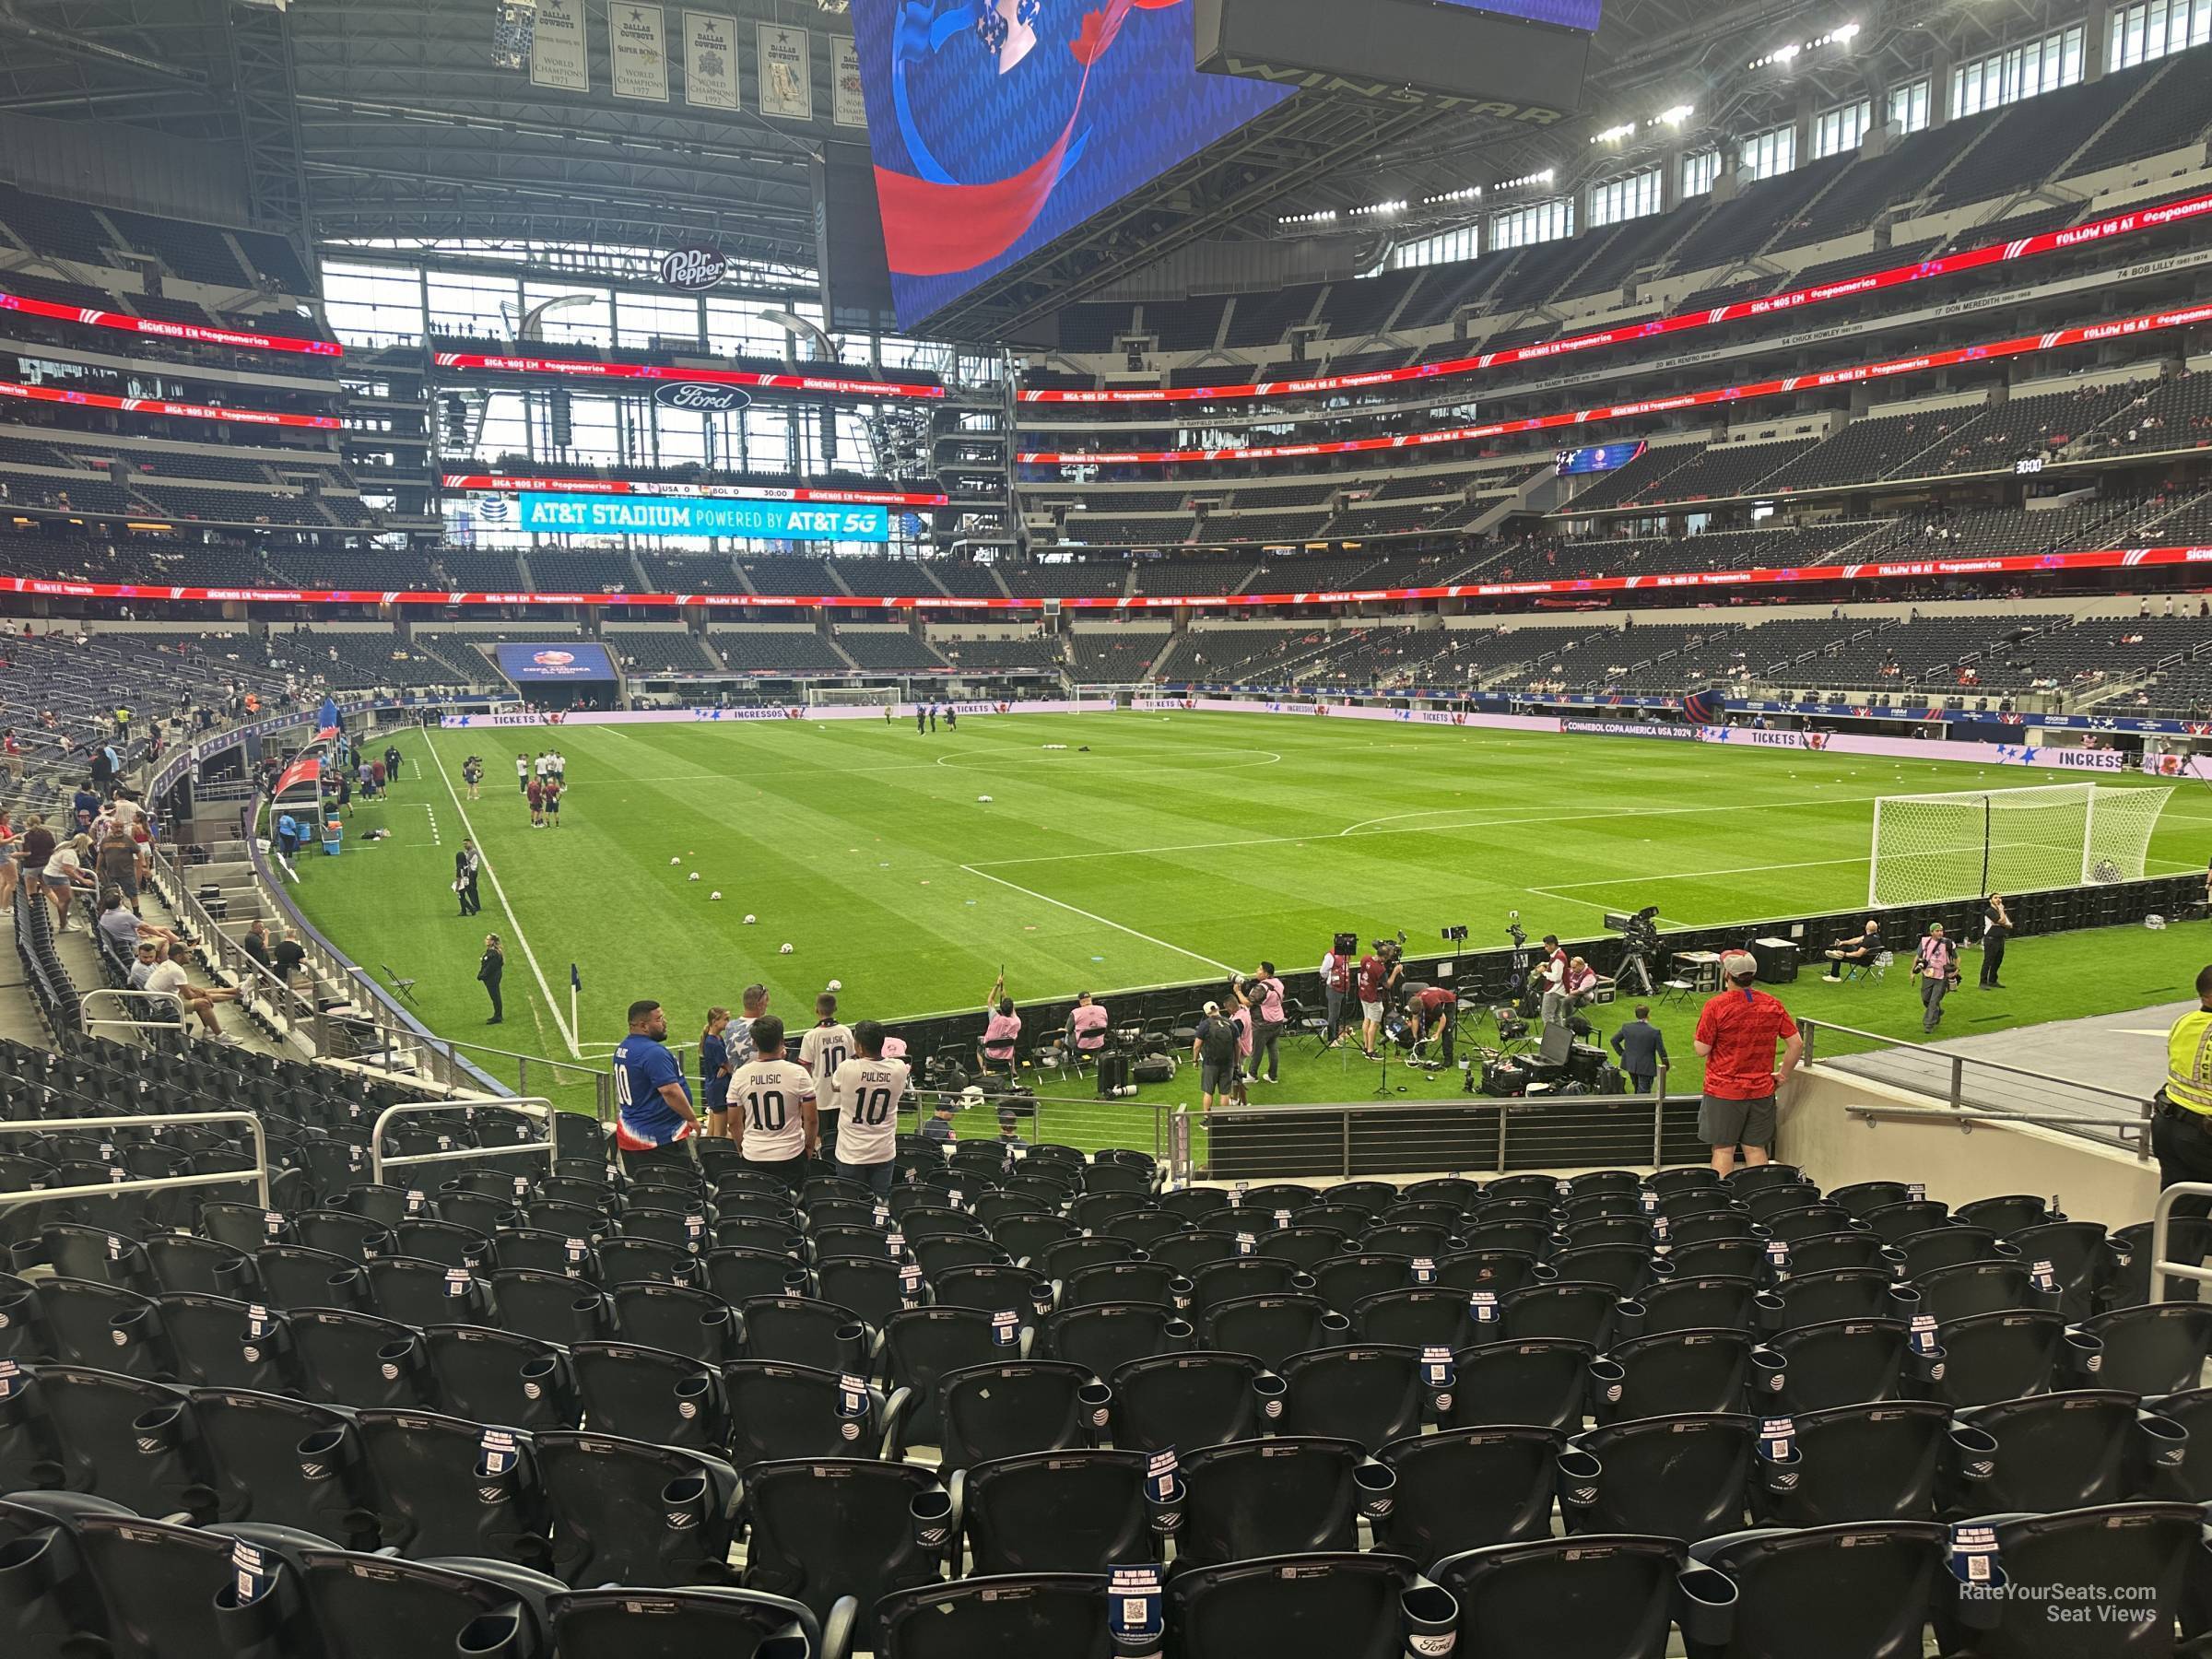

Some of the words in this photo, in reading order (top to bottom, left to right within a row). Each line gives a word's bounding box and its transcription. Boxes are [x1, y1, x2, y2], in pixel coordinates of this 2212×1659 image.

[542, 10, 571, 20] DALLAS
[539, 18, 574, 29] COWBOYS
[623, 22, 651, 32] DALLAS
[620, 29, 654, 41] COWBOYS
[698, 33, 724, 42] DALLAS
[618, 45, 637, 54] SUPER
[694, 41, 727, 51] COWBOYS
[771, 45, 796, 53] DALLAS
[544, 57, 574, 67] WORLD
[535, 65, 583, 77] CHAMPIONS
[625, 68, 654, 78] WORLD
[551, 76, 568, 85] 1971
[617, 76, 665, 88] CHAMPIONS
[699, 78, 725, 88] WORLD
[632, 87, 649, 95] 1977
[690, 85, 735, 97] CHAMPIONS
[1226, 58, 1563, 124] WINSTAR
[704, 95, 722, 104] 1992
[2056, 226, 2100, 246] FOLLOW
[2103, 221, 2117, 234] US
[2120, 218, 2134, 229] AT
[688, 250, 711, 268] Dr
[669, 252, 724, 286] Pepper
[2117, 270, 2127, 278] 74
[2131, 265, 2150, 276] BOB
[2152, 260, 2174, 273] LILLY
[1751, 298, 1790, 312] SIGA-NOS
[1792, 294, 1805, 305] EM
[1810, 278, 1877, 299] @copaamerica
[1946, 303, 1961, 314] DON
[1963, 297, 2000, 312] MEREDITH
[138, 319, 183, 336] SÍGUENOS
[185, 327, 199, 339] EN
[199, 329, 270, 347] @copaamerica
[2083, 324, 2122, 340] FOLLOW
[2123, 321, 2136, 331] US
[2137, 319, 2150, 330] AT
[1792, 333, 1812, 344] CHUCK
[1814, 328, 1840, 339] HOWLEY
[484, 358, 524, 369] SIGA-NOS
[526, 360, 539, 369] EM
[1677, 355, 1700, 365] RENFRO
[1818, 371, 1853, 384] SIGA-NOS
[1854, 369, 1866, 380] EM
[673, 383, 732, 409] Ford
[2016, 458, 2042, 475] 30:00
[534, 480, 547, 488] EM
[662, 485, 678, 493] USA
[764, 489, 787, 498] 30:00
[531, 502, 587, 524] AT&T
[592, 504, 690, 527] STADIUM
[696, 509, 762, 528] POWERED
[767, 512, 782, 528] BY
[787, 512, 841, 532] AT&T
[842, 513, 877, 533] 5G
[1879, 563, 1911, 574] FOLLOW
[1912, 564, 1922, 573] US
[1923, 563, 1934, 573] AT
[493, 715, 535, 724] TICKETS
[735, 710, 782, 719] INGRESSOS
[1423, 712, 1448, 723] TICKETS
[1568, 722, 1605, 733] CONMEBOL
[1606, 724, 1624, 734] COPA
[1624, 726, 1656, 735] AMERICA
[1657, 727, 1672, 736] USA
[1673, 728, 1691, 737] 2024
[1752, 732, 1795, 746] TICKETS
[822, 1035, 845, 1046] PULISIC
[821, 1045, 846, 1078] 10
[750, 1074, 782, 1085] PULISIC
[861, 1071, 891, 1084] PULISIC
[615, 1063, 632, 1106] 10
[747, 1090, 785, 1131] 10
[852, 1087, 890, 1126] 10
[1420, 1637, 1453, 1653] Ford
